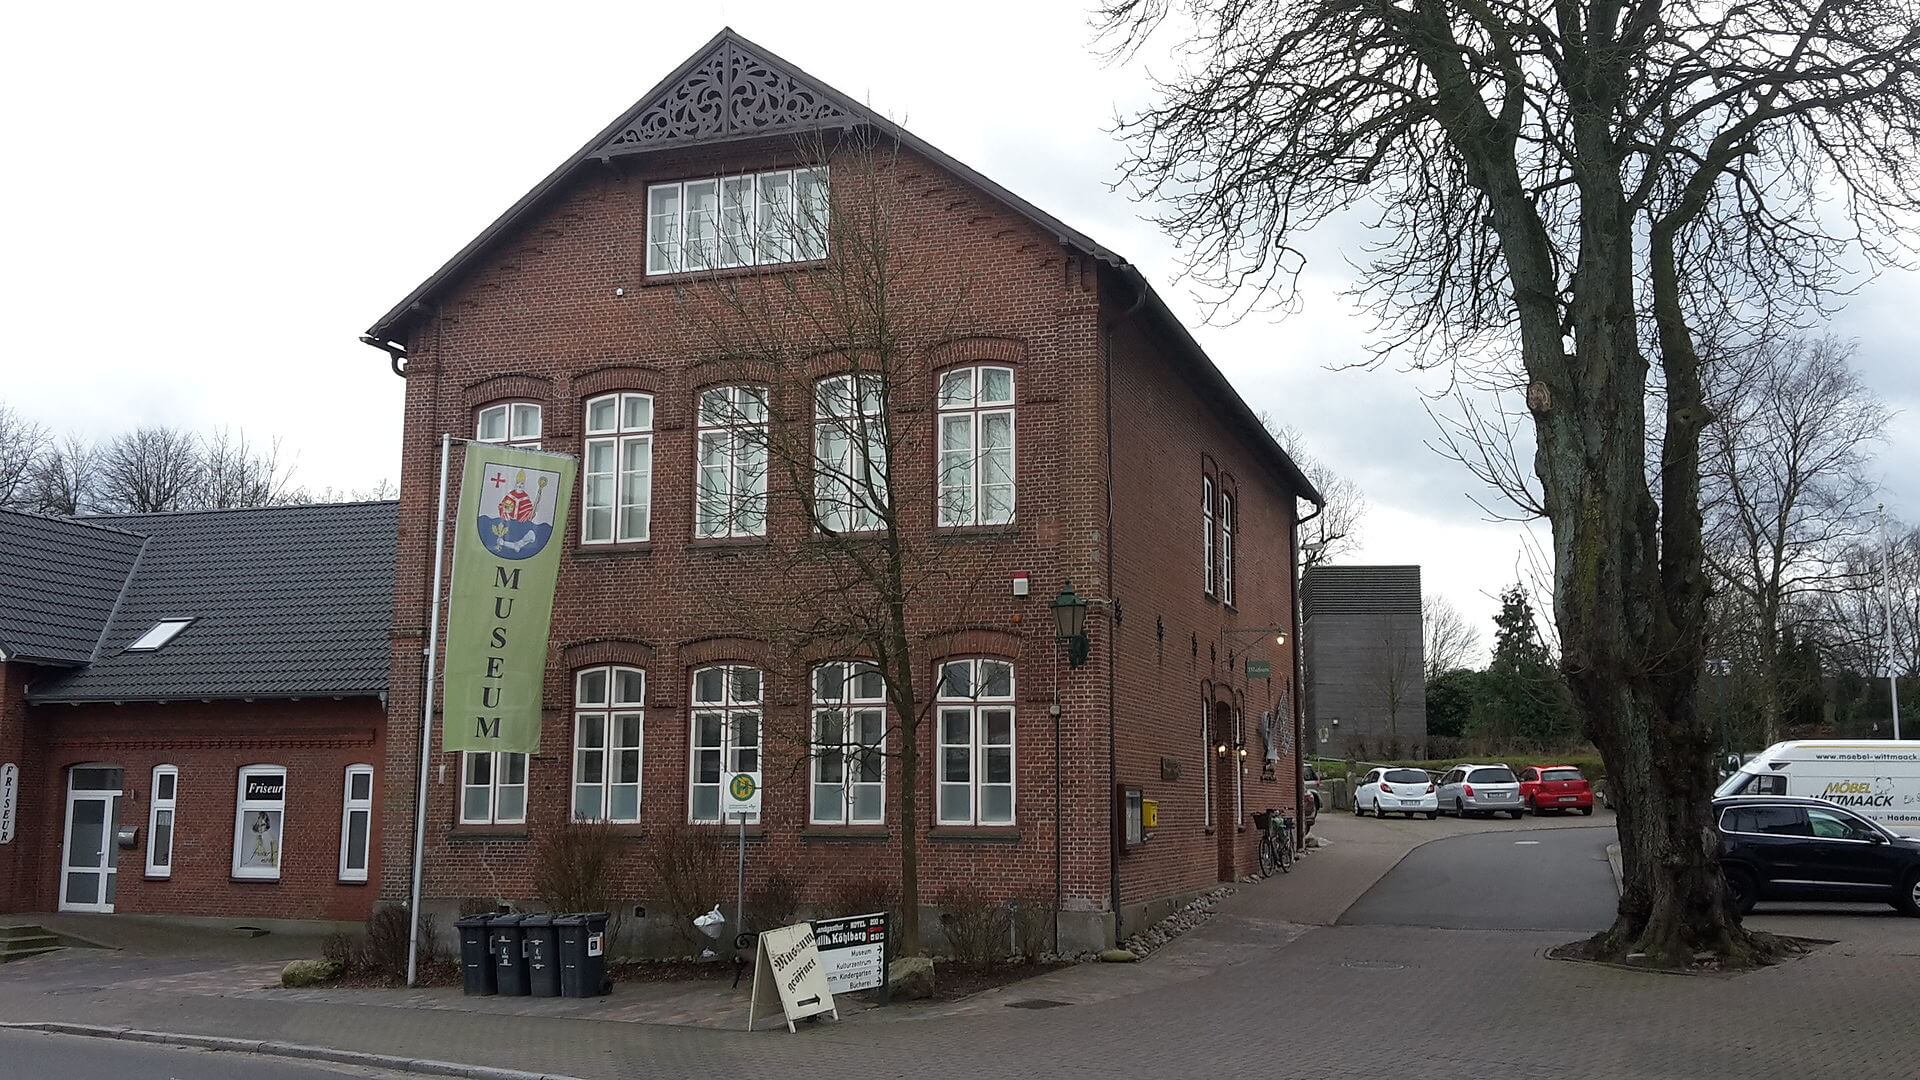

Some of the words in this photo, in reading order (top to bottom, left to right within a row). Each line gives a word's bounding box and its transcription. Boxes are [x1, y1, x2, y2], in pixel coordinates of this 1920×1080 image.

[474, 565, 522, 739] MUSEUM
[248, 782, 284, 794] Friseur
[1825, 780, 1871, 793] MÖBEL
[1, 766, 13, 841] FRISEUR
[850, 920, 866, 929] HOTEL
[851, 949, 872, 957] Museum
[836, 959, 872, 970] Kulturzentrum
[840, 970, 872, 980] Kindergarten
